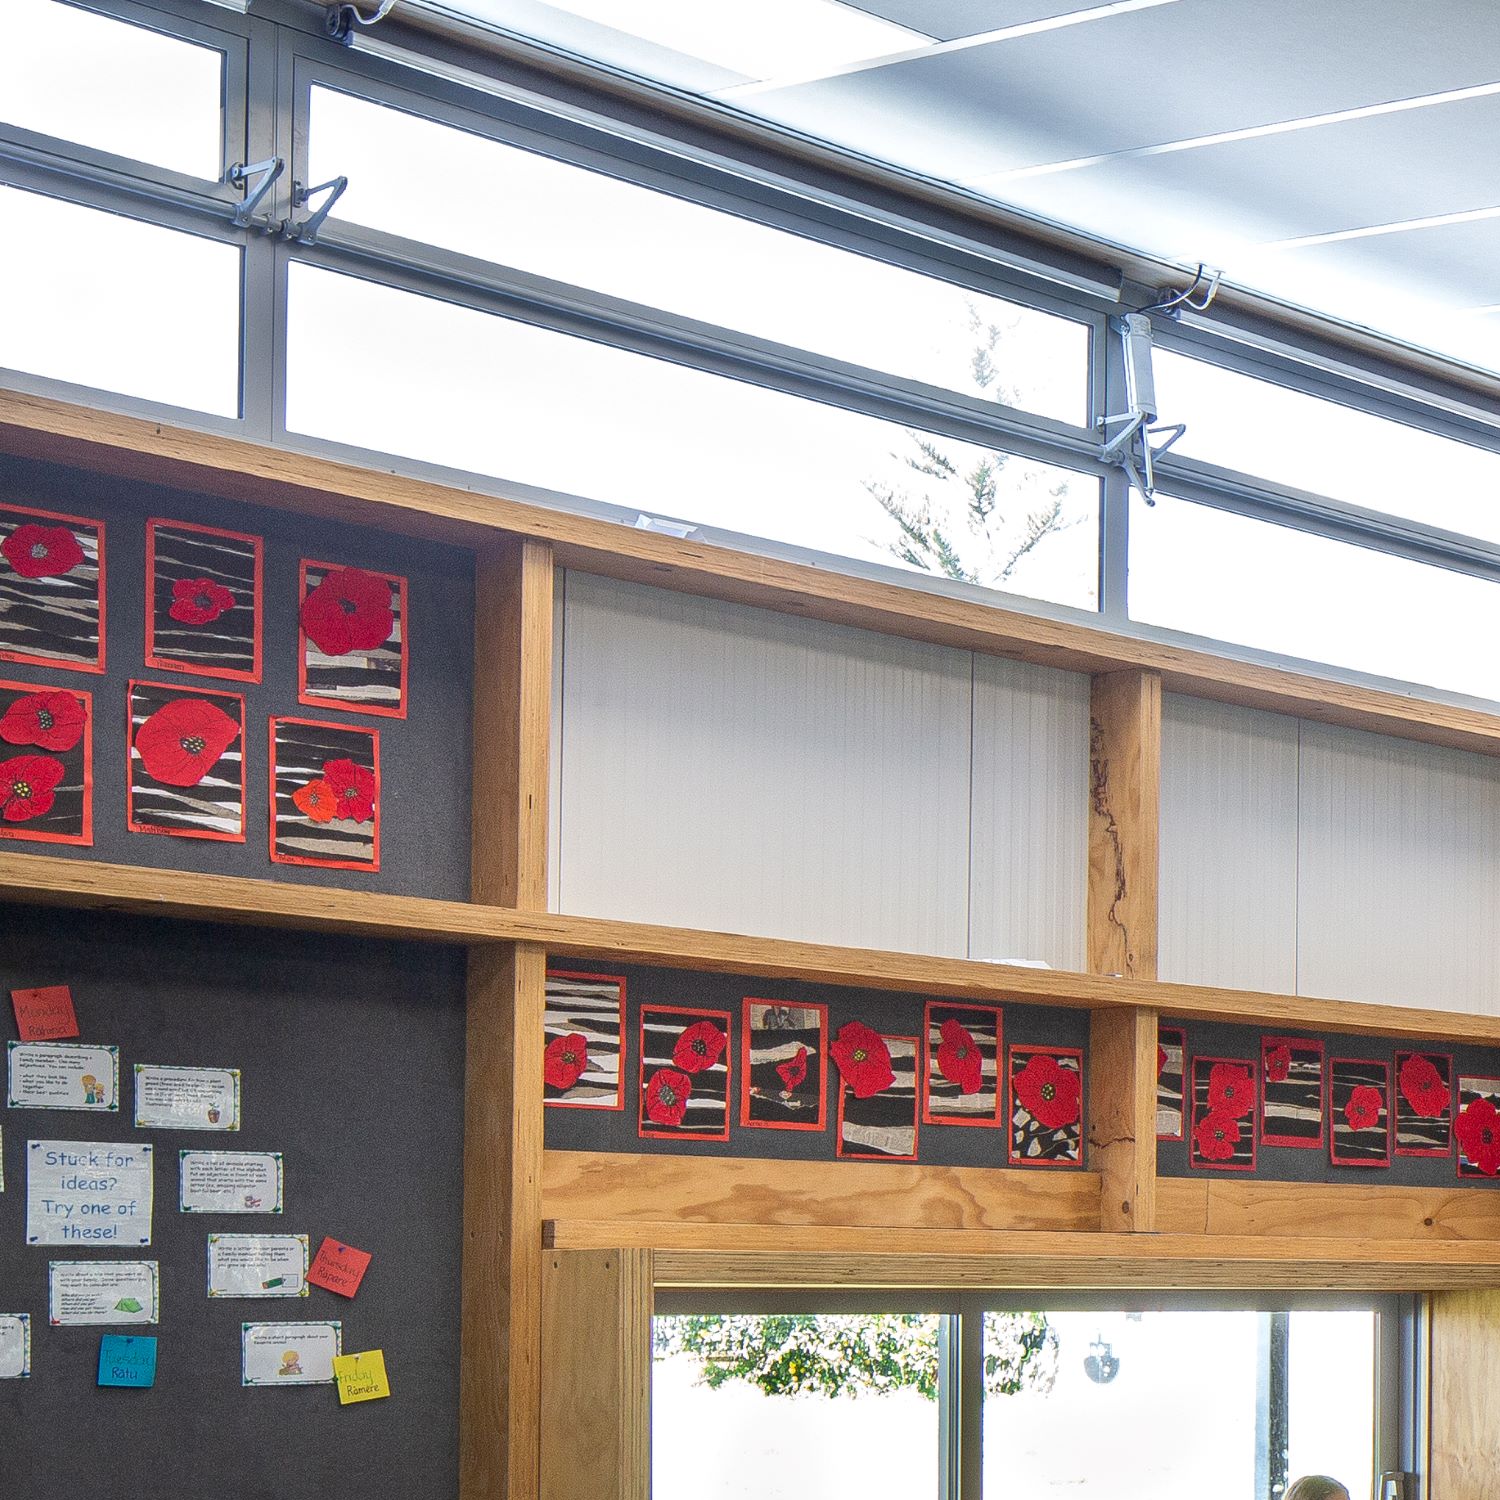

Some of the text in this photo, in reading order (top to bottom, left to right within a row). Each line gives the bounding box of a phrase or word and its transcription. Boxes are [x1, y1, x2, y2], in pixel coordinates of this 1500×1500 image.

[45, 1151, 134, 1167] Stuck for
[61, 1175, 118, 1190] ideas?
[41, 1199, 137, 1217] Try one of
[61, 1224, 118, 1239] these!
